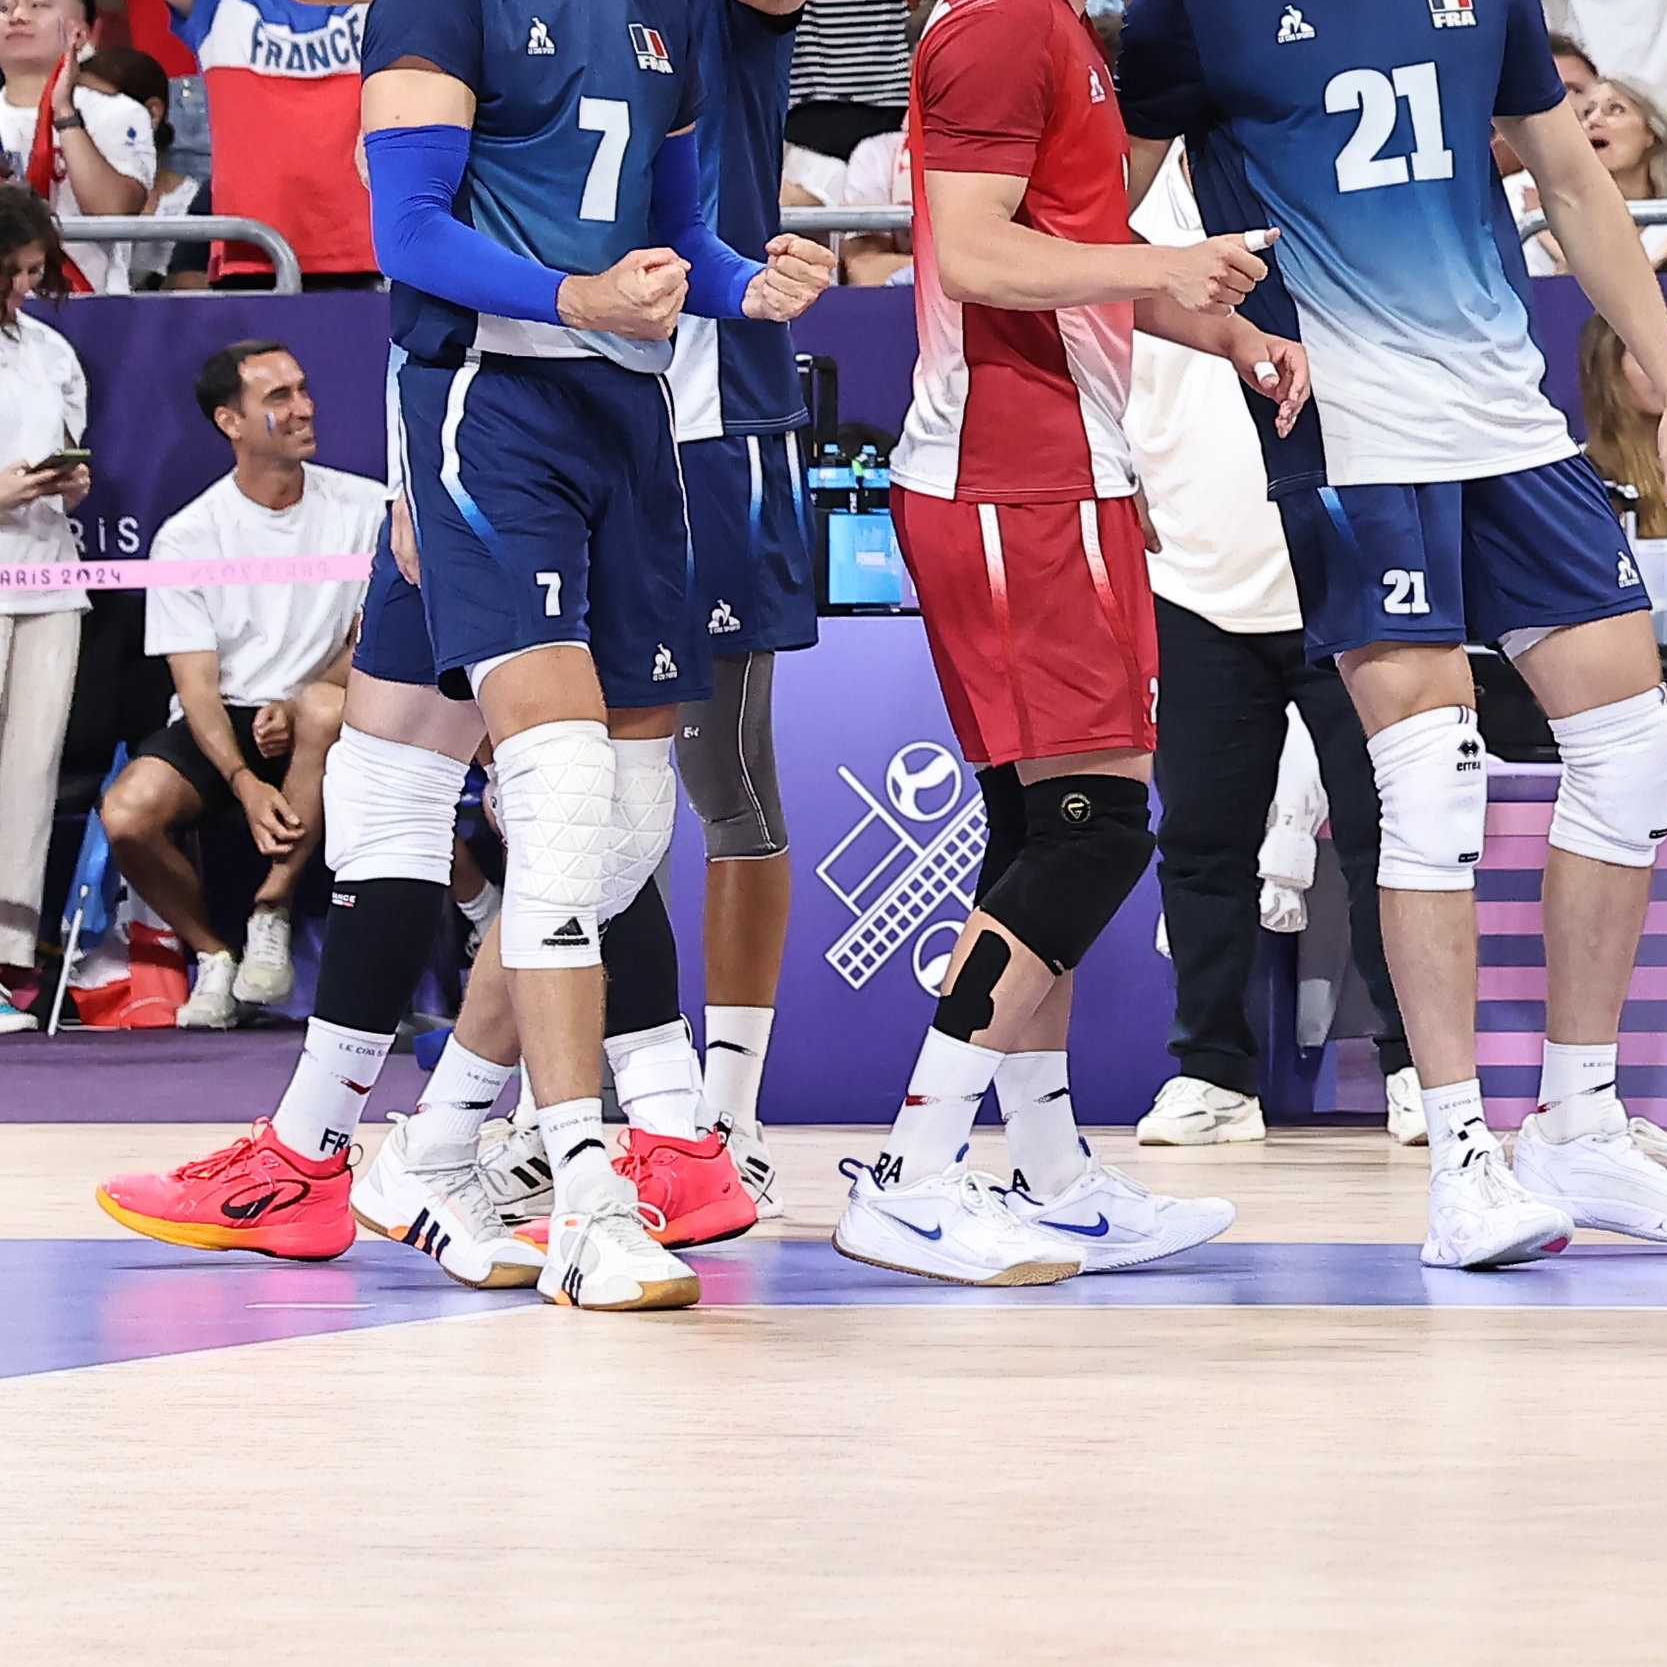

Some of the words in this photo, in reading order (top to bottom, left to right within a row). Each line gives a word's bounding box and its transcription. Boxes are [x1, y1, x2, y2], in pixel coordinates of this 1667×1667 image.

[250, 11, 364, 71] FRANCE
[1431, 10, 1478, 29] FRA
[1323, 59, 1454, 195] 21
[578, 95, 631, 222] 7
[536, 572, 561, 616] 7
[1382, 569, 1431, 614] 21
